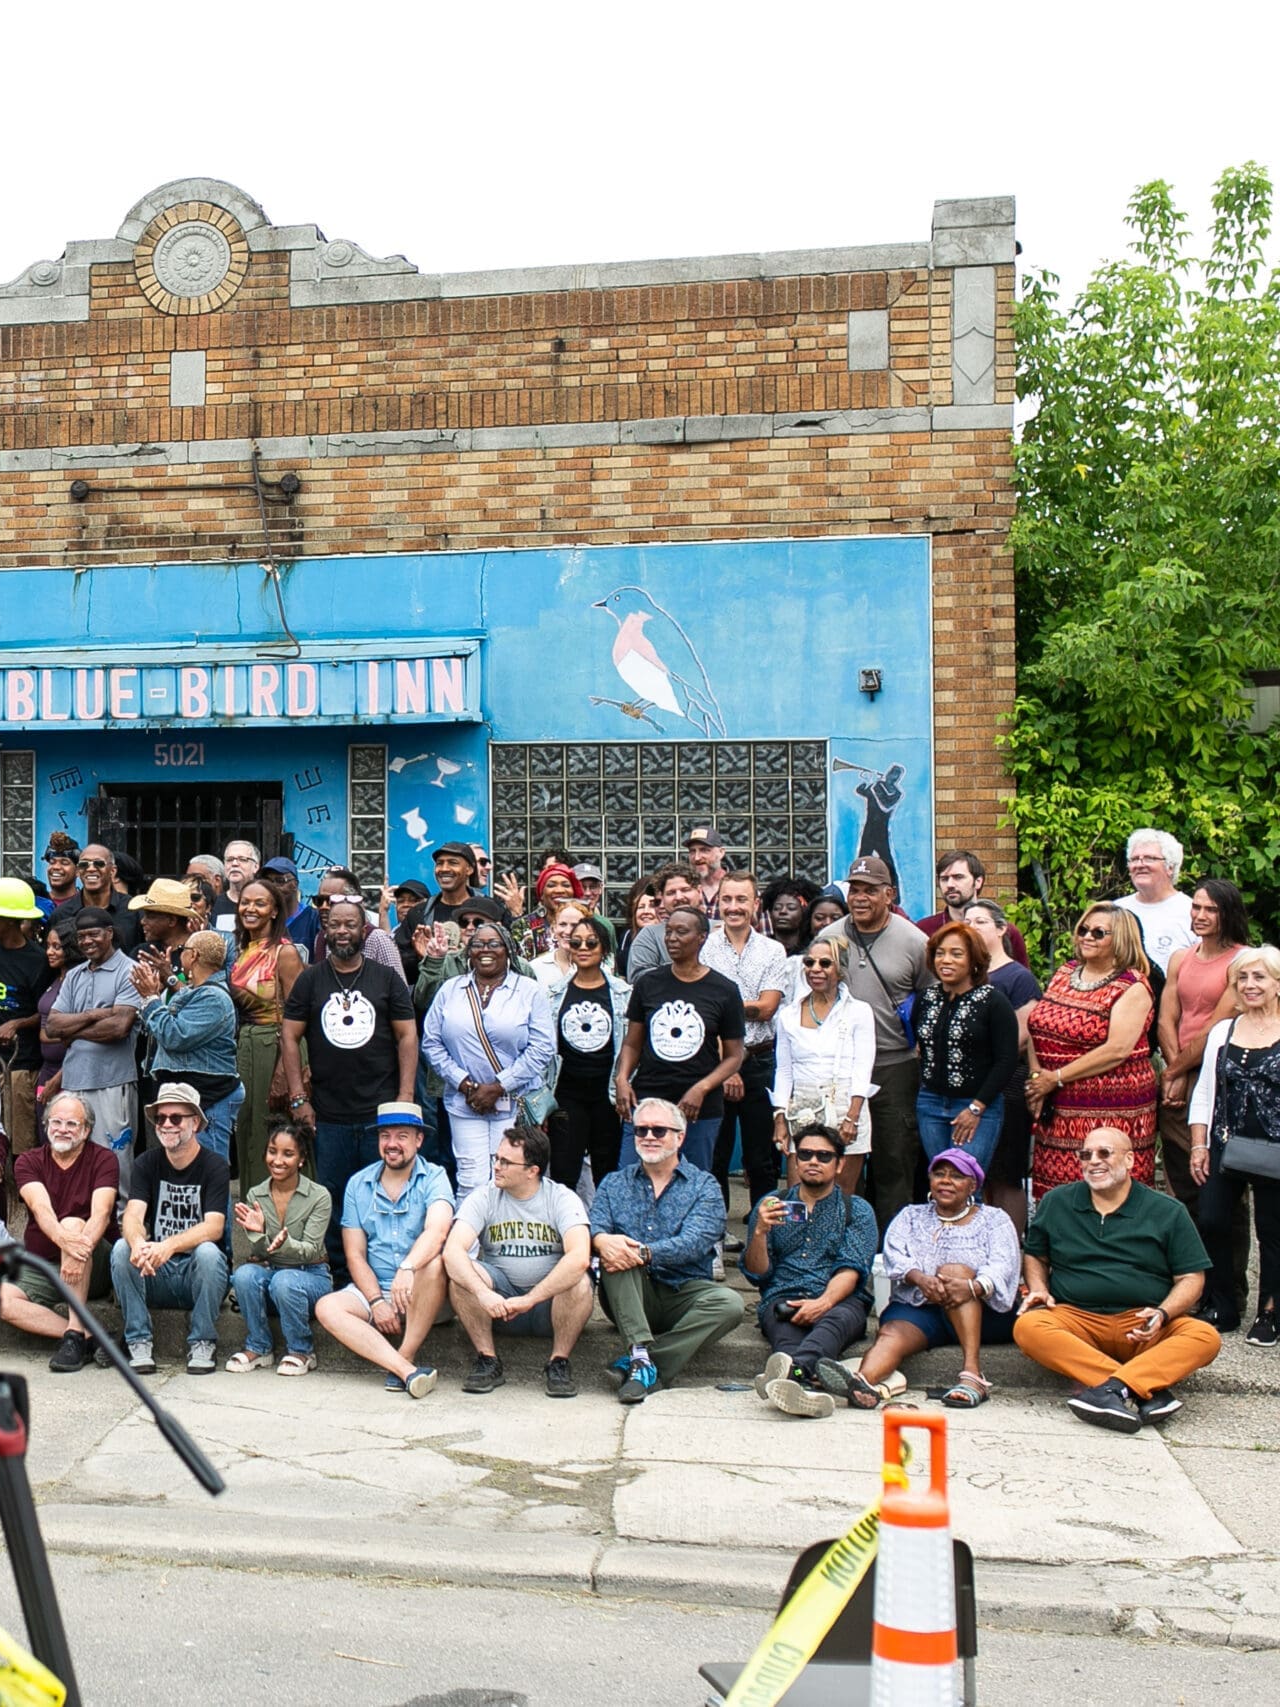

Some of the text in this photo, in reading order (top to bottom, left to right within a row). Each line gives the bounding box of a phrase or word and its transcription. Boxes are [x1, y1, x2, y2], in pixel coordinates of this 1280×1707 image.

[7, 663, 317, 721] BLUE-BIRD
[368, 657, 464, 715] INN
[154, 743, 205, 767] 5021
[161, 1200, 201, 1220] PUNK
[158, 1218, 185, 1230] THAN
[488, 1221, 524, 1243] WAYNE
[498, 1244, 553, 1257] ALUMNI
